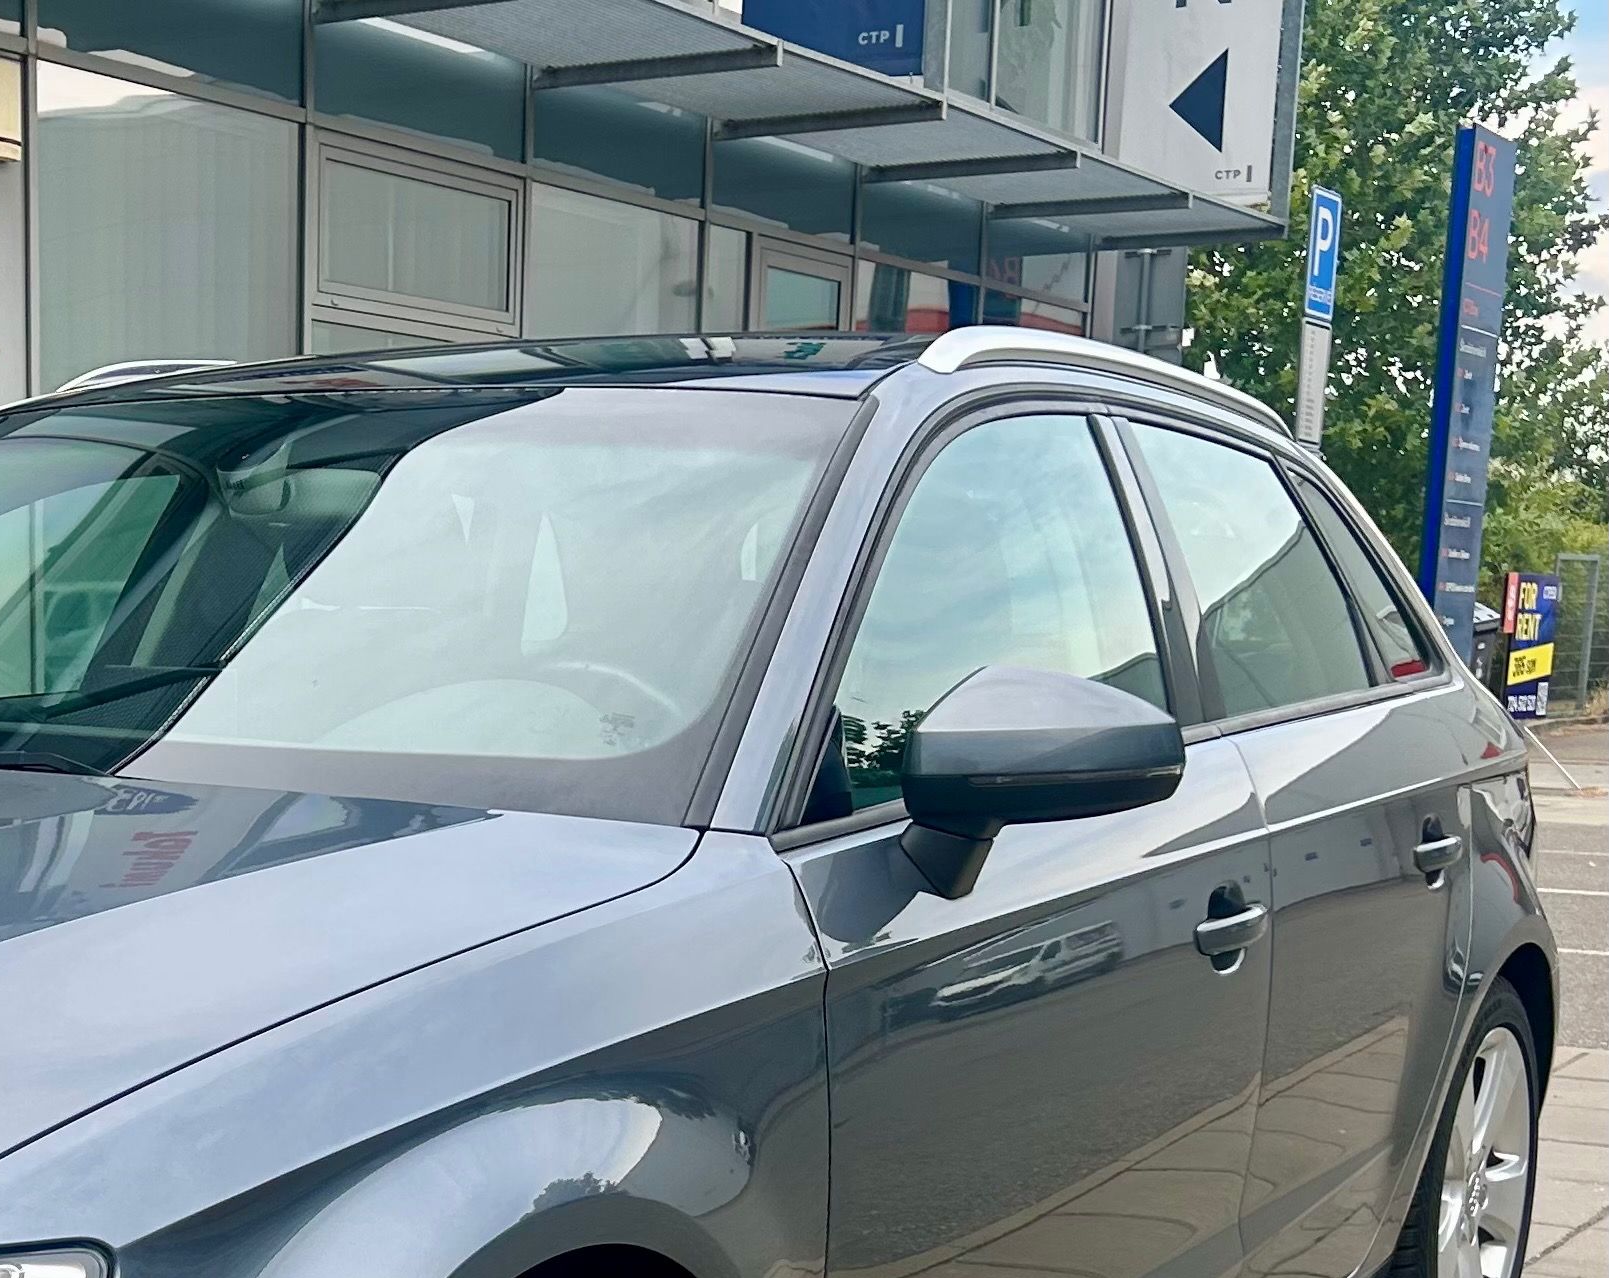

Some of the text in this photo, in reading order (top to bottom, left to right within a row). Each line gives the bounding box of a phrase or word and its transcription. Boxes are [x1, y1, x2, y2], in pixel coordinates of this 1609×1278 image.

[858, 31, 890, 45] CTP
[1215, 169, 1241, 180] CTP
[1474, 140, 1497, 197] B3
[1313, 205, 1333, 277] P
[1468, 208, 1489, 264] B4
[1518, 582, 1538, 609] FOR
[1515, 613, 1542, 641] RENT
